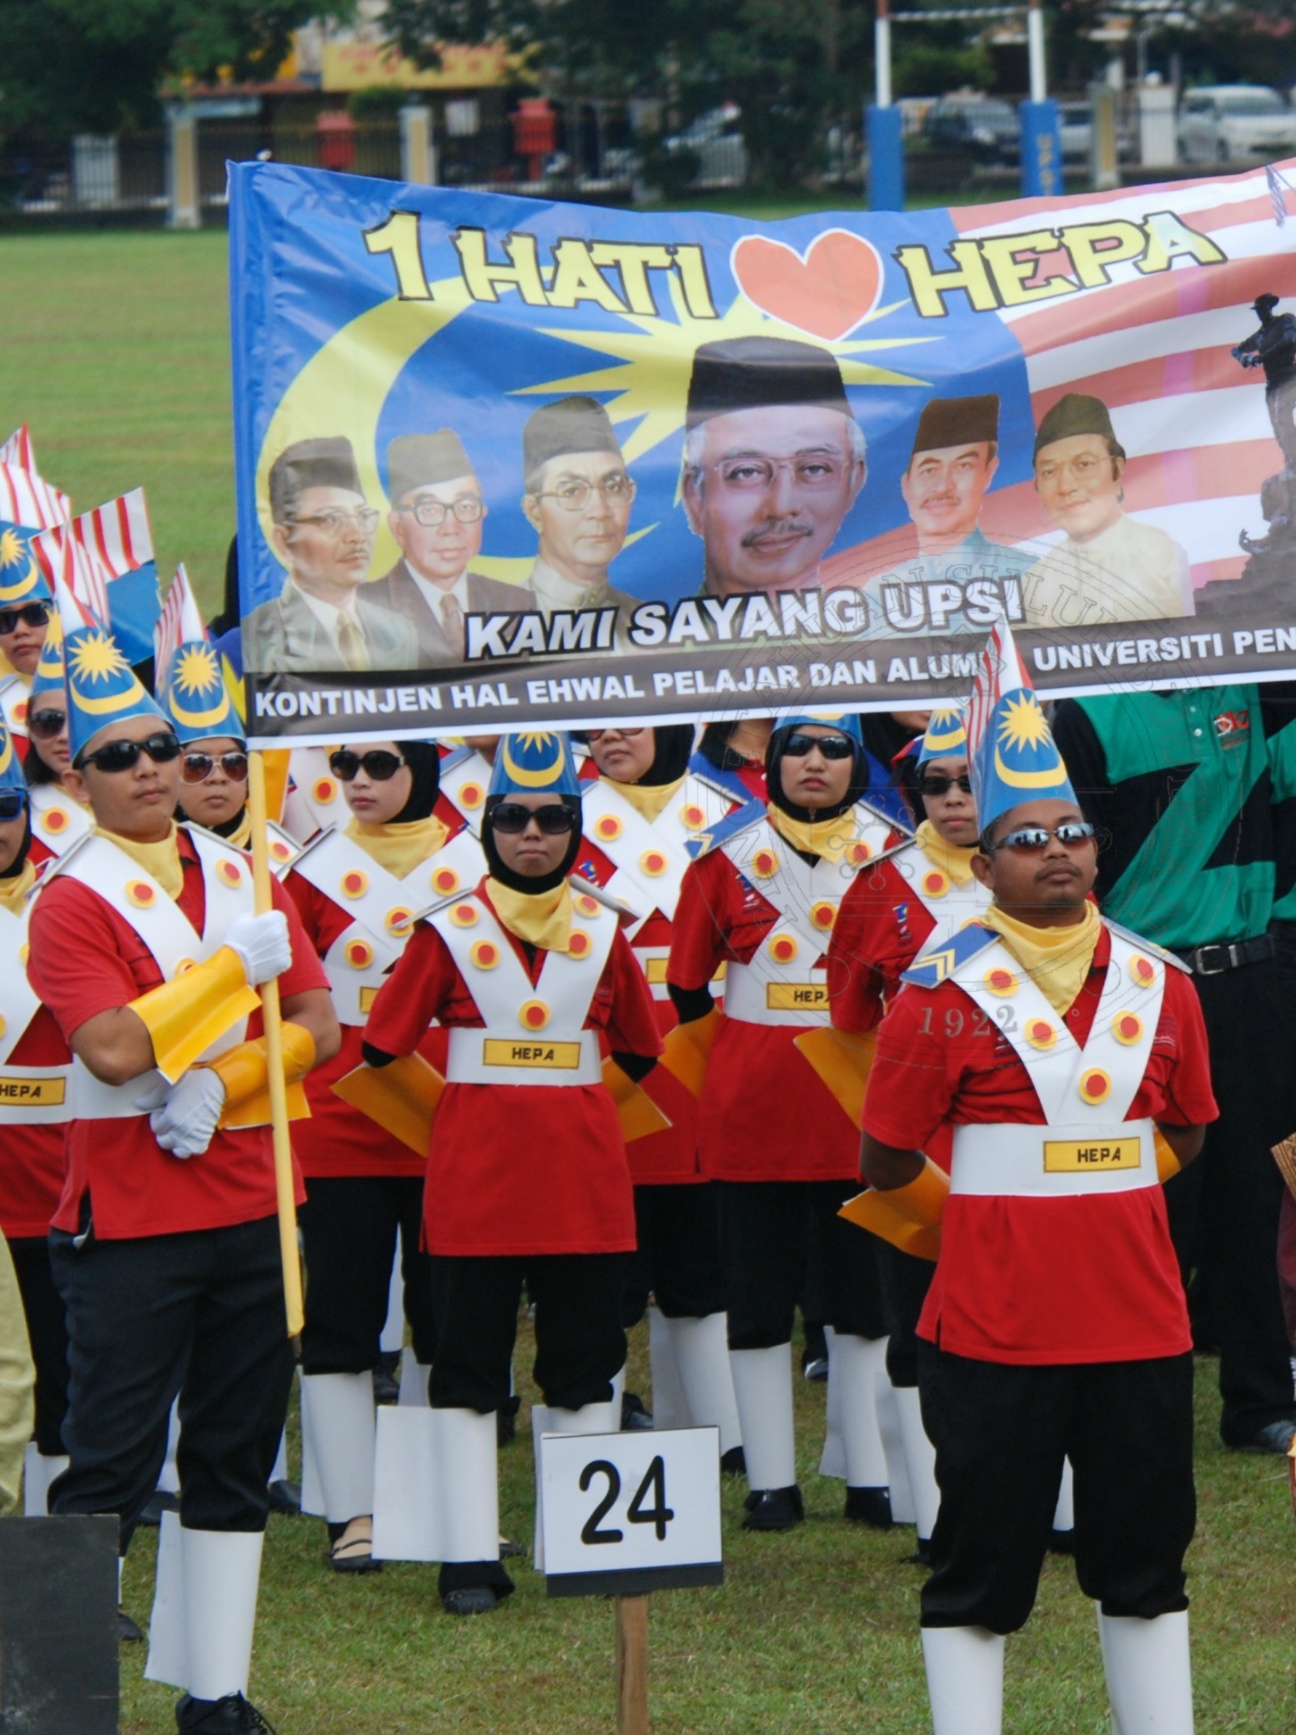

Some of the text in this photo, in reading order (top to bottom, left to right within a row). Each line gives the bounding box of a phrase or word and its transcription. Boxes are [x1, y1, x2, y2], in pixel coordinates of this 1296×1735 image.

[362, 209, 434, 301] 1
[891, 210, 1229, 318] HEPA
[464, 576, 1027, 663] KAMI SAYANG UPSI
[255, 686, 442, 718] KONTINJEN
[451, 683, 519, 709] HAL
[527, 675, 645, 704] EHWAL
[654, 664, 801, 697] PELAJAR
[810, 658, 878, 687] DAN
[887, 651, 982, 683] ALUM
[1033, 632, 1223, 671] UNIVERSITI
[0, 1084, 42, 1098] HEPA
[512, 1047, 555, 1061] HEPA
[1077, 1147, 1122, 1163] HEPA
[578, 1454, 675, 1546] 24
